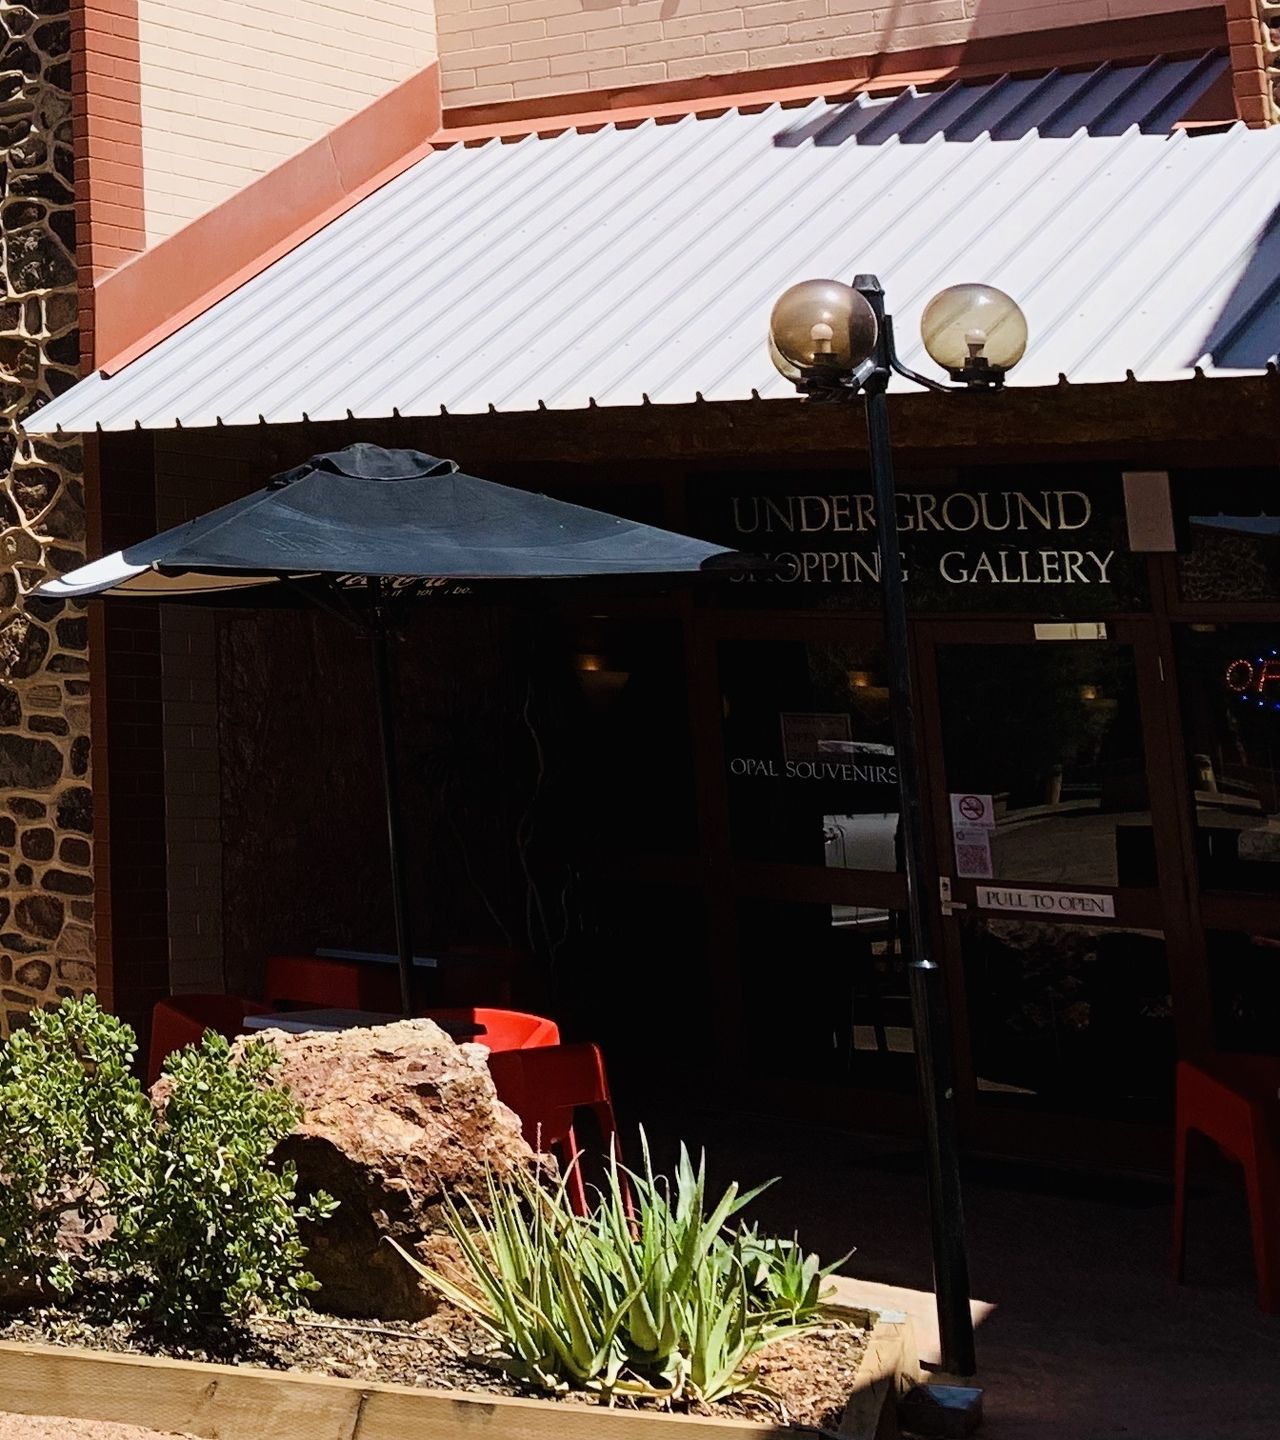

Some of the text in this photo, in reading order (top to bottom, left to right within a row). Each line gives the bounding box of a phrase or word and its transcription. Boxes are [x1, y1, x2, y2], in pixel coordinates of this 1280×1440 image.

[730, 490, 1093, 533] UNDERGROUND
[729, 550, 1116, 584] OPPIN GALLERY
[730, 757, 899, 784] OPAL SOUVENIRS
[986, 890, 1105, 913] PULL TO OPEN
